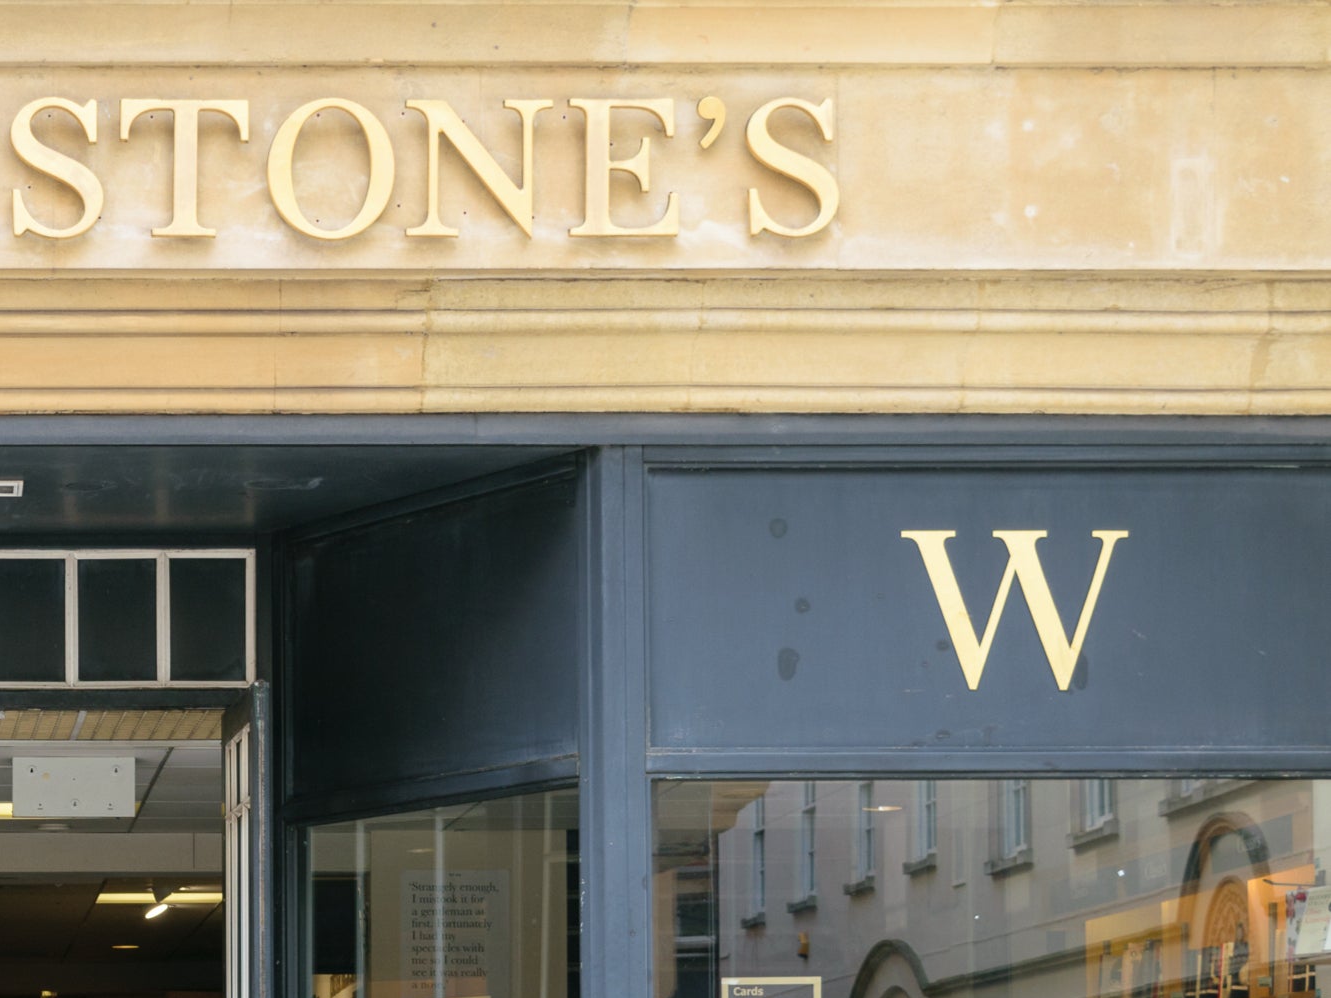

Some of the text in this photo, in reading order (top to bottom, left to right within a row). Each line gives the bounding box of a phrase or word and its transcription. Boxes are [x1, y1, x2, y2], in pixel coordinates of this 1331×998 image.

[899, 529, 1130, 691] W
[471, 894, 484, 903] for
[463, 943, 484, 953] with
[412, 955, 478, 965] me could
[412, 968, 427, 977] see
[733, 986, 764, 997] Cards
